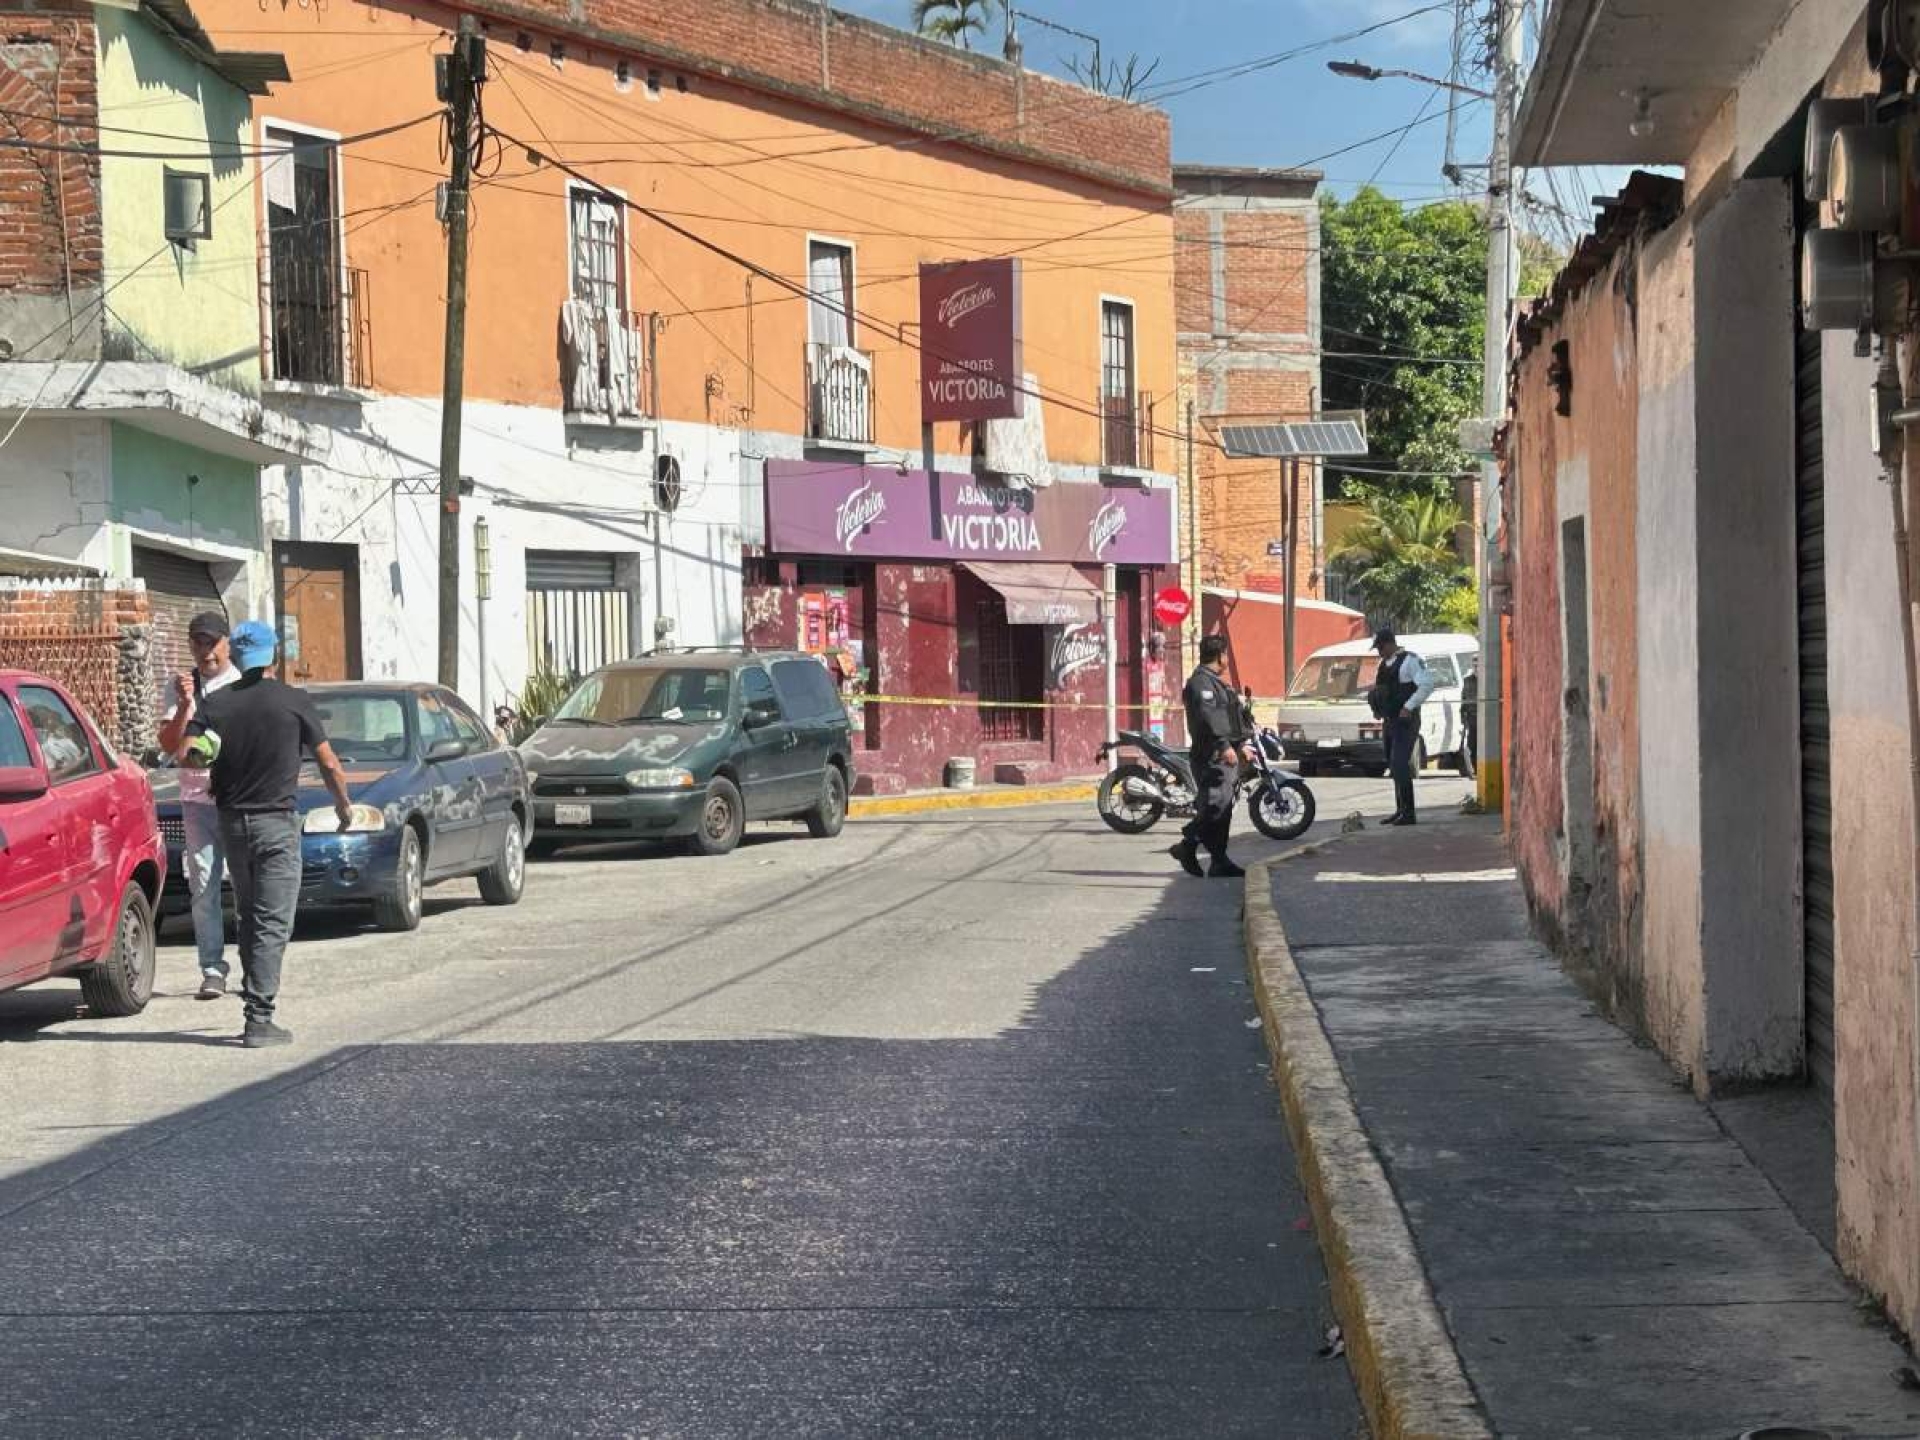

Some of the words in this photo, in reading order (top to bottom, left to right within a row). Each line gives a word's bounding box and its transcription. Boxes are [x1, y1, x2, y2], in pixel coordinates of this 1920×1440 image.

[936, 281, 996, 329] Victoria
[929, 378, 1006, 403] VICTORIA
[836, 479, 886, 551] Victoria
[943, 513, 1042, 551] VICTORIA
[1089, 496, 1127, 561] Victoria
